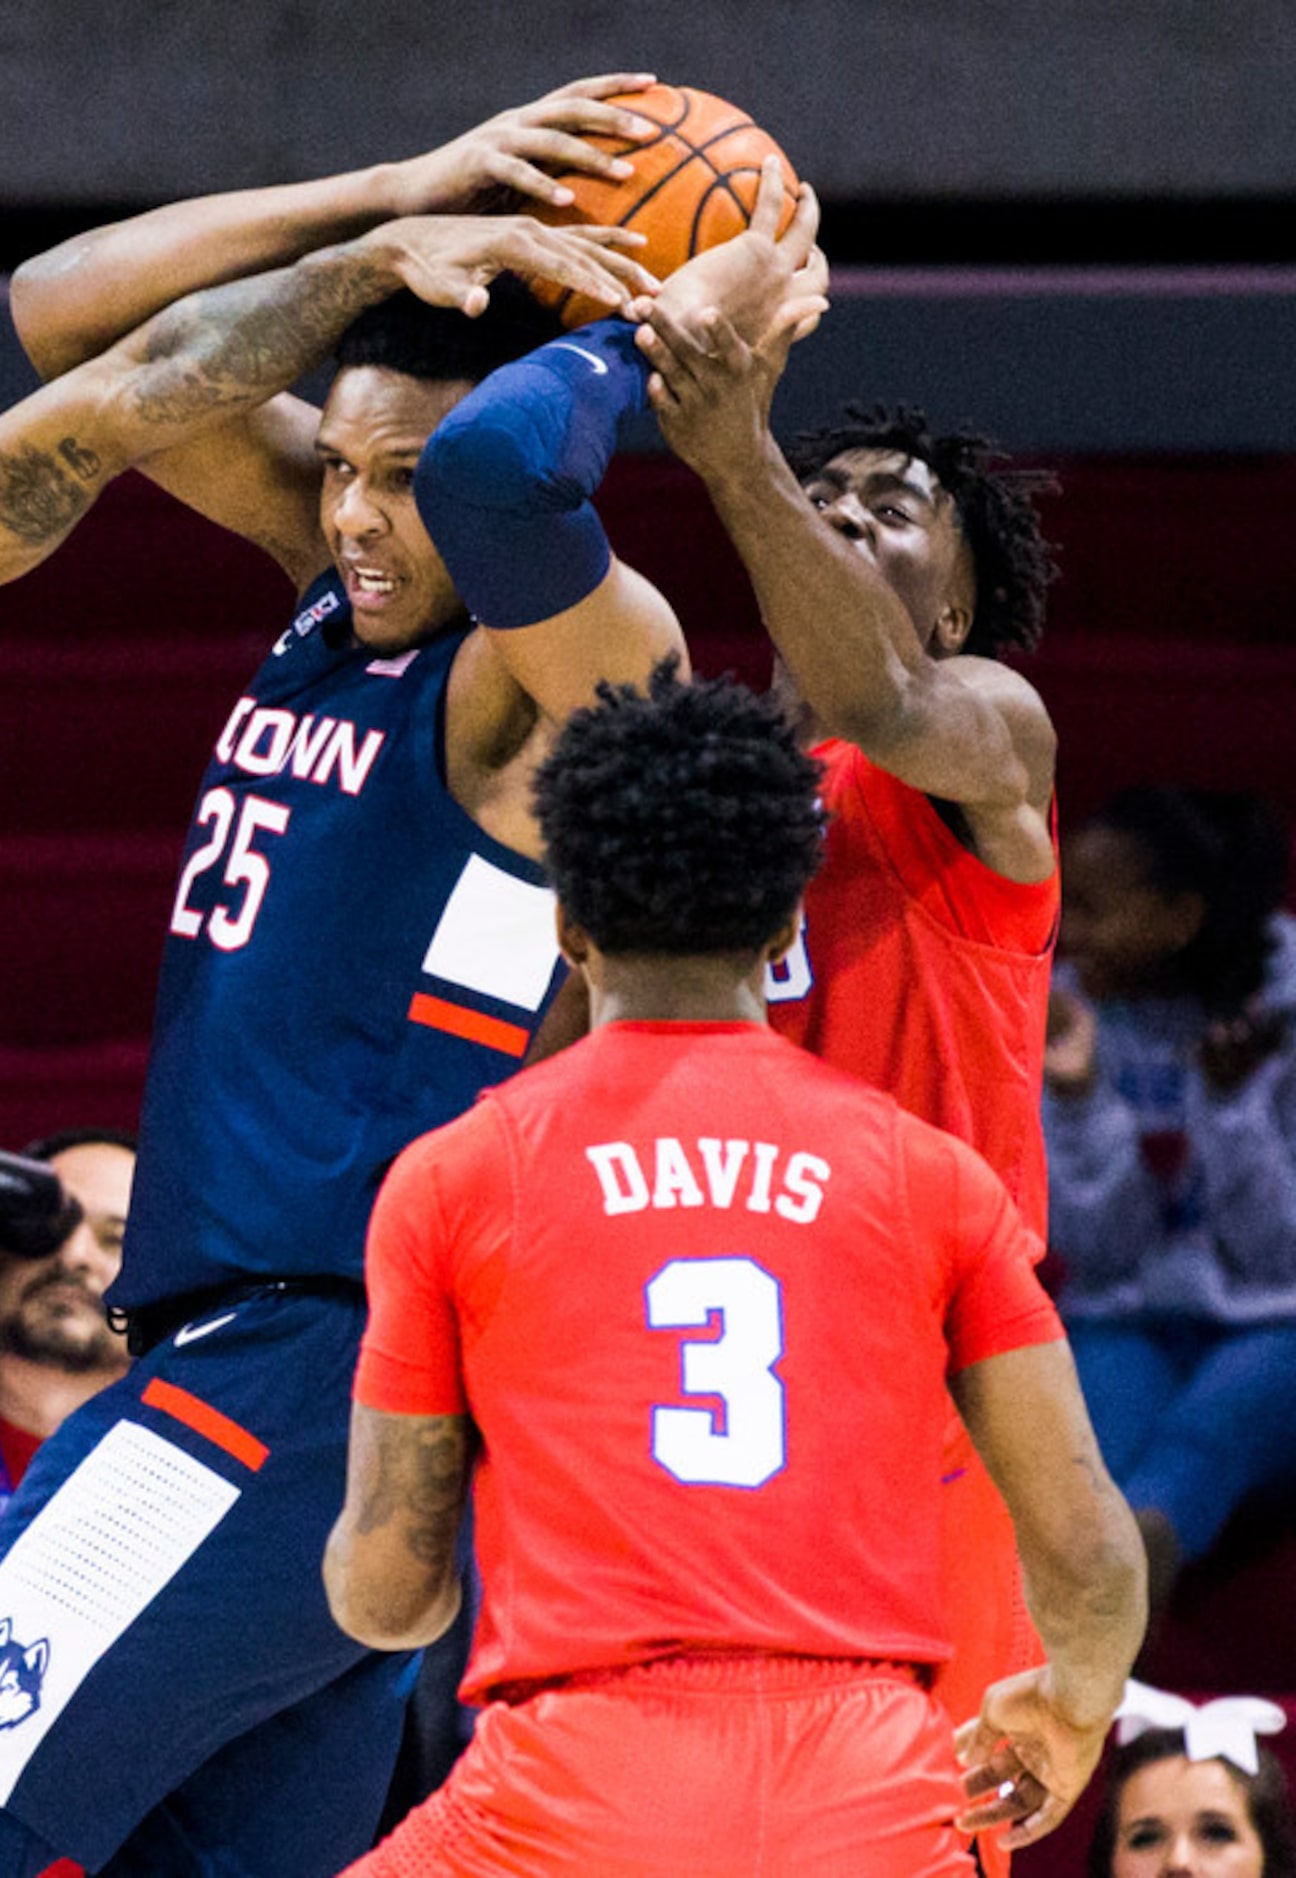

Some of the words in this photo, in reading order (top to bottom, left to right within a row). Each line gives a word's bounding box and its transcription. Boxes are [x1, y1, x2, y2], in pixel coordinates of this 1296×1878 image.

[169, 785, 293, 953] 25
[585, 1136, 832, 1225] DAVIS
[642, 1253, 788, 1492] 3
